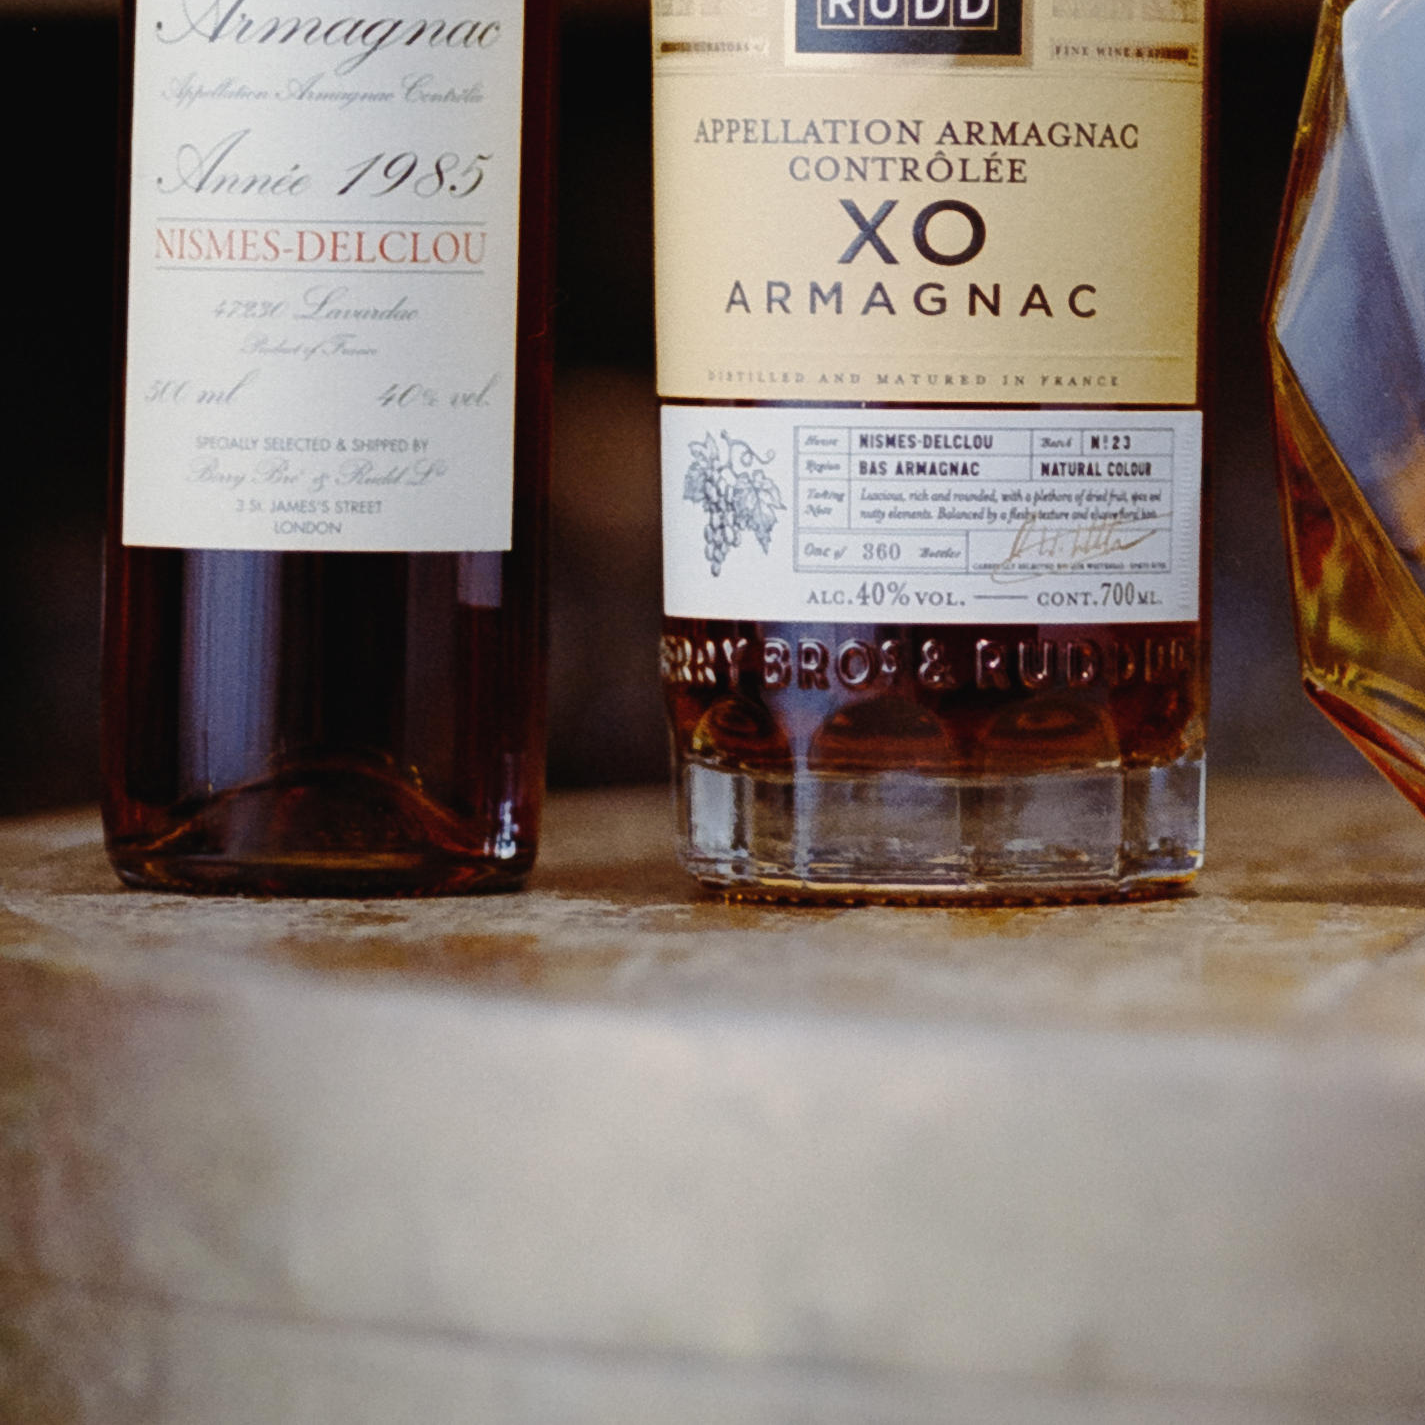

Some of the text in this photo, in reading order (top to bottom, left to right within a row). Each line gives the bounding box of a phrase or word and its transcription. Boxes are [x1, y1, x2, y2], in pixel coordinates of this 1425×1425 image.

[693, 118, 1140, 150] APPELLATION ARMAGNAC
[156, 128, 495, 200] Année 1985
[788, 150, 1029, 185] CONTRÔLÉE
[838, 198, 988, 267] XO
[155, 227, 489, 266] NISMES-DELCLOU
[725, 279, 1098, 319] ARMAGNAC
[706, 369, 1120, 388] DISTILLED AND MATURED IN FRANCE
[263, 436, 332, 453] SELECTED
[335, 436, 348, 453] &
[411, 438, 431, 455] BY
[858, 433, 995, 450] NISMES-DELCLOU
[859, 460, 981, 477] BAS ARMAGNAC
[1040, 461, 1153, 478] NATURAL COLOUR
[908, 488, 929, 502] rich
[930, 488, 951, 502] and
[952, 488, 999, 504] rounded,
[335, 500, 383, 516] STREET
[937, 506, 986, 521] Balanced
[986, 506, 999, 525] by
[273, 520, 343, 537] LONDON
[914, 589, 967, 608] VOL.
[762, 638, 901, 690] BROS
